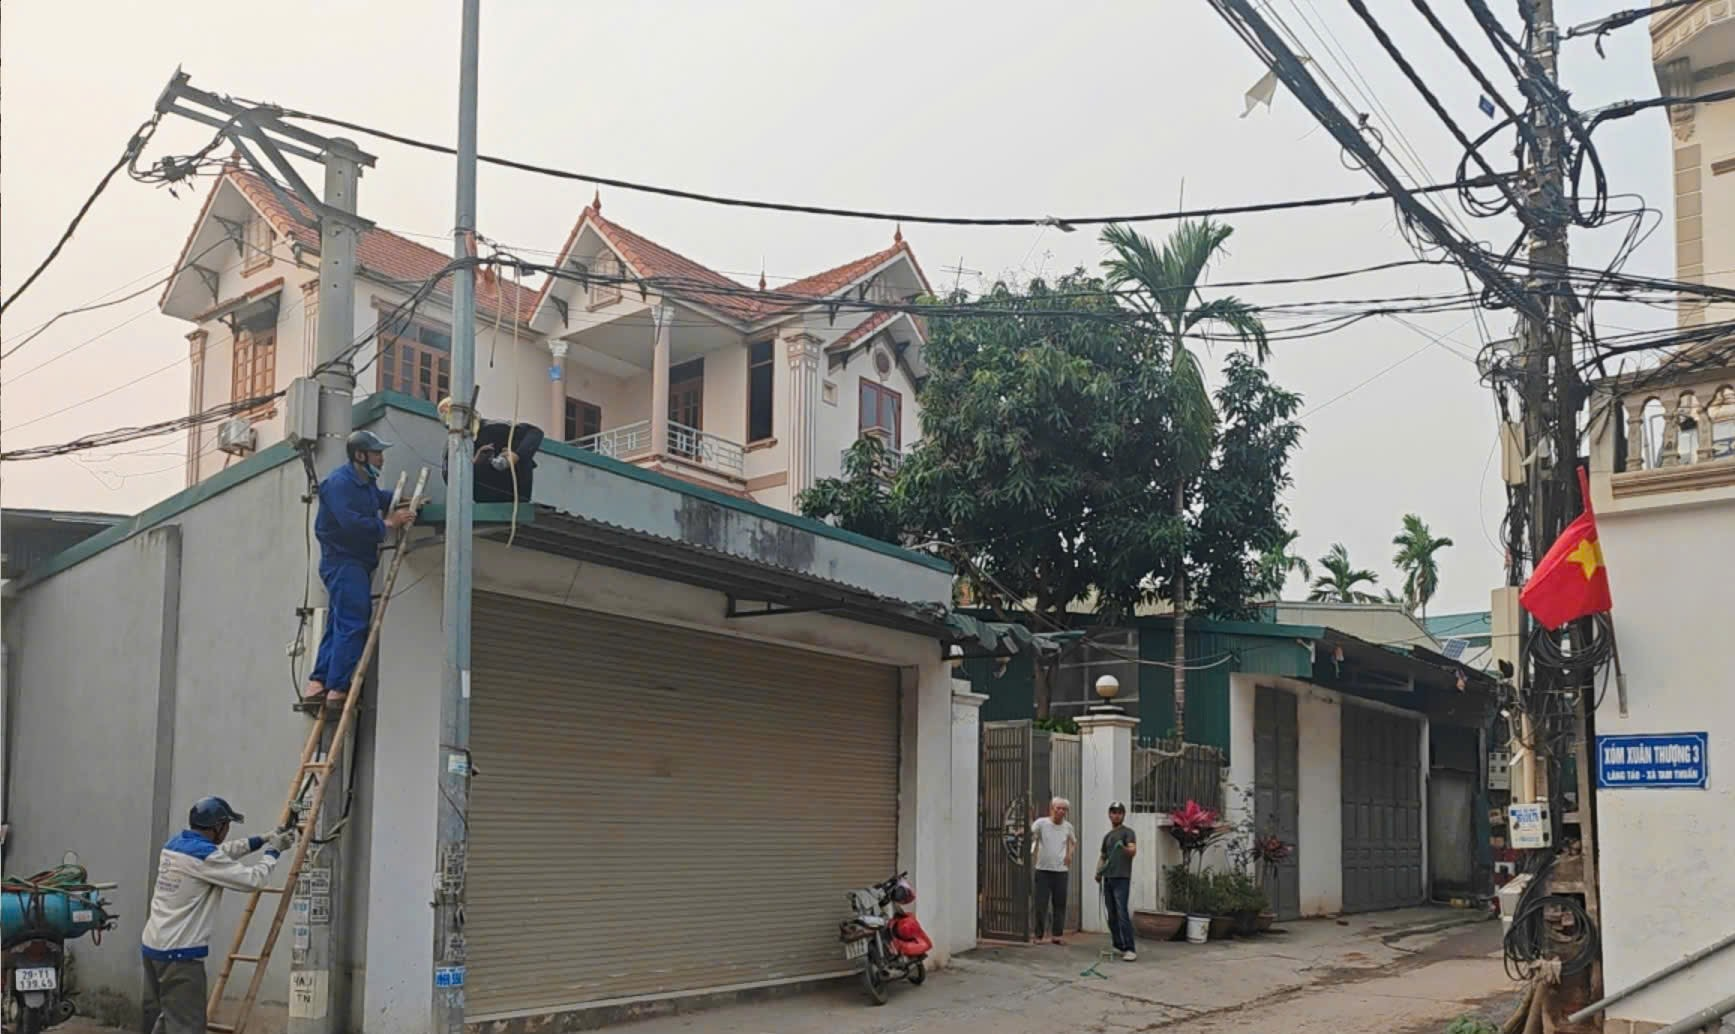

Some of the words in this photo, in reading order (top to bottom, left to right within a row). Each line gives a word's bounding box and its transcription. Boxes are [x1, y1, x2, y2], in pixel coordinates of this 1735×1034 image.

[1604, 743, 1625, 764] XÓM
[1627, 743, 1652, 764] XUÂN
[1654, 744, 1691, 767] THƯỢNG
[1692, 745, 1700, 763] 3
